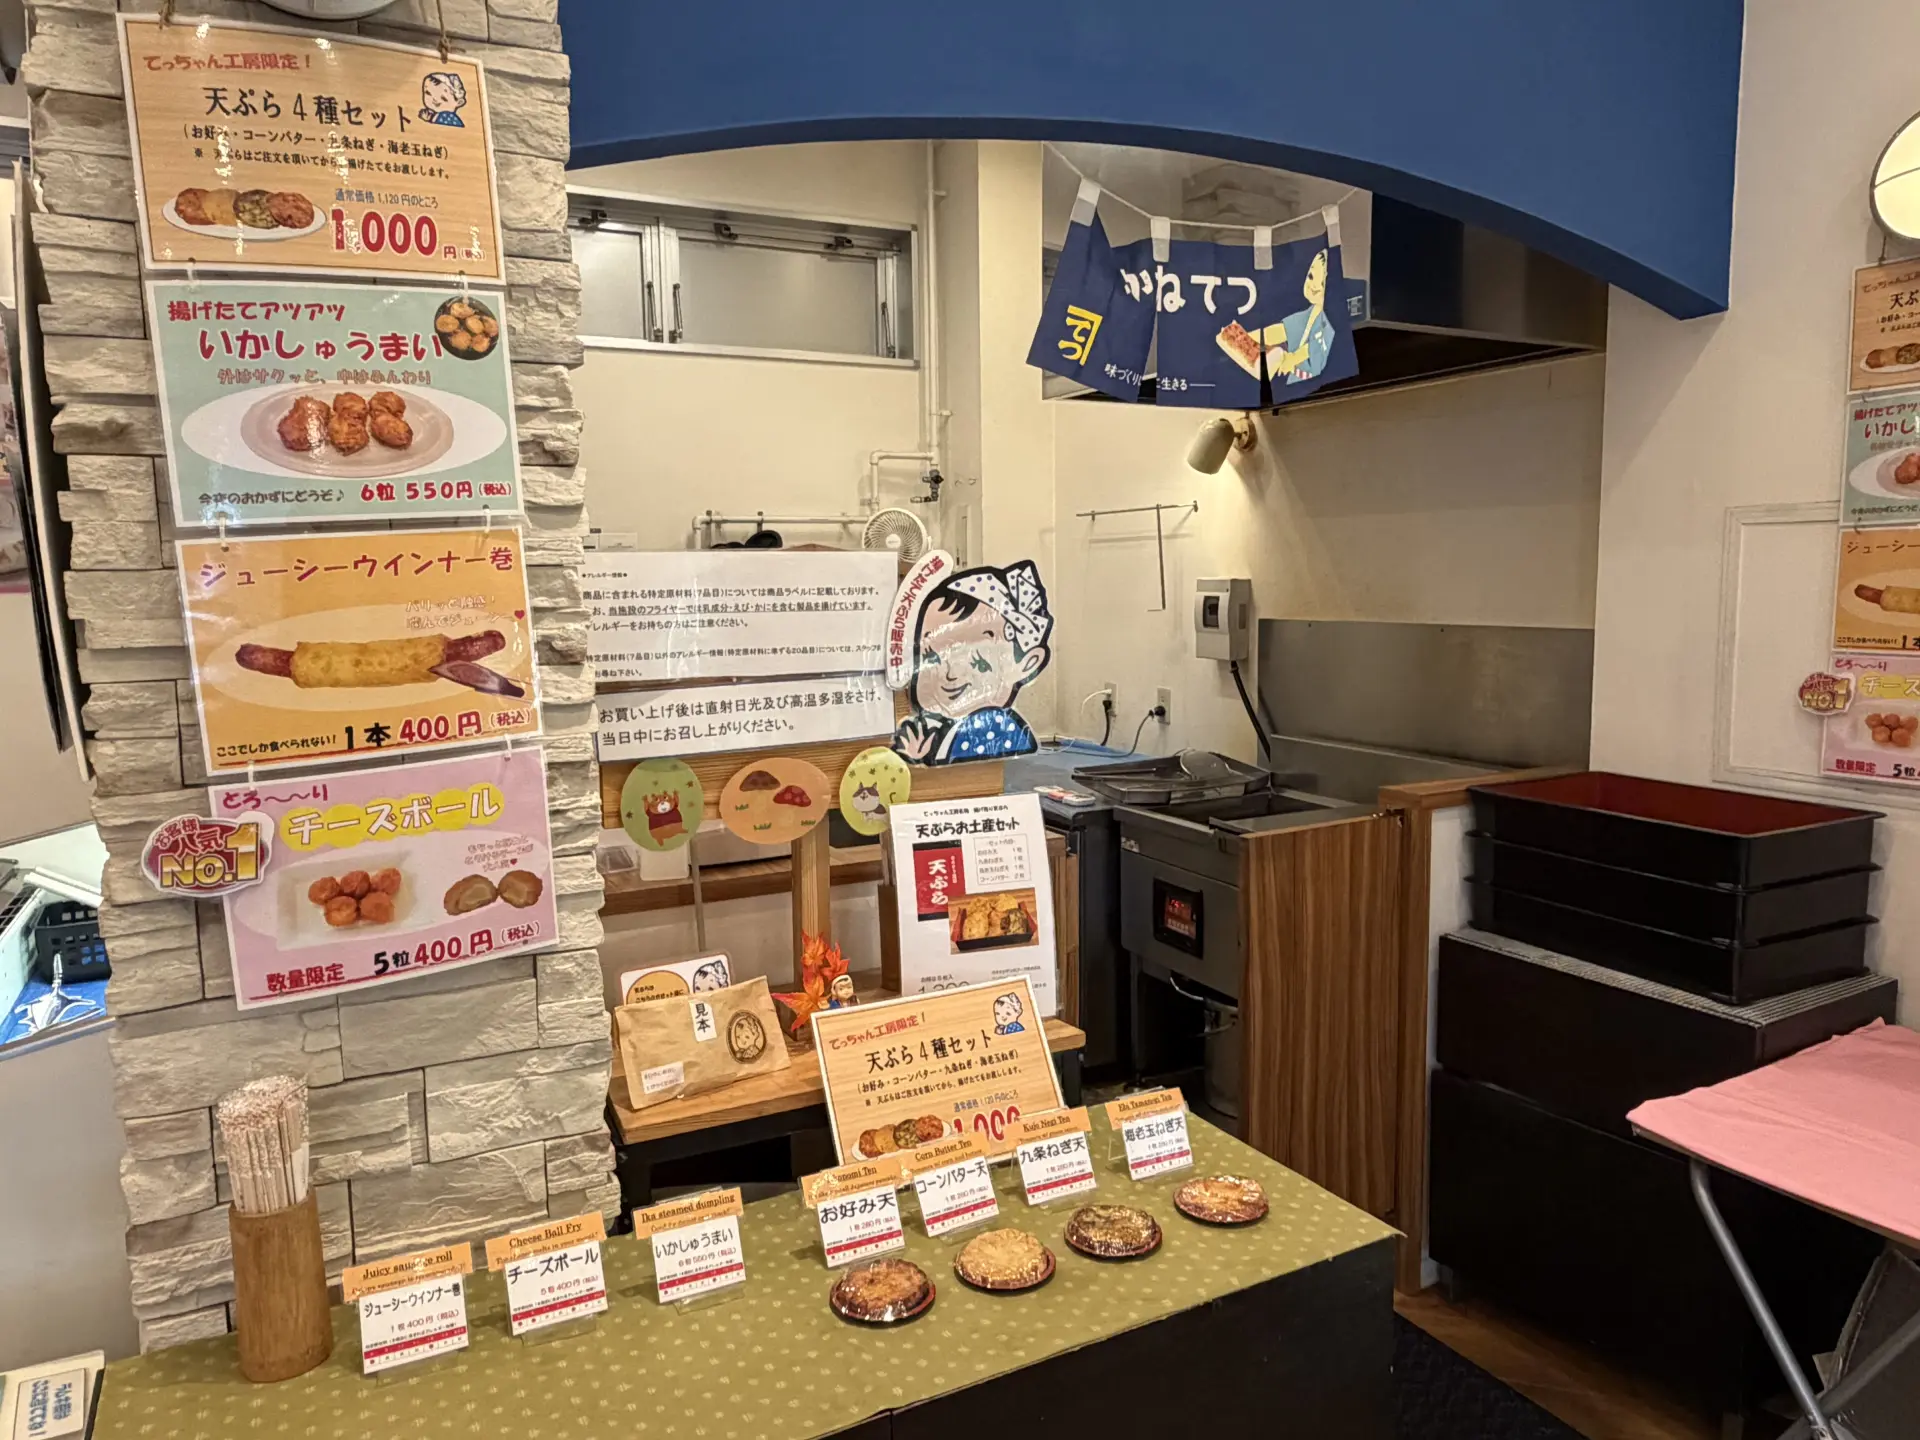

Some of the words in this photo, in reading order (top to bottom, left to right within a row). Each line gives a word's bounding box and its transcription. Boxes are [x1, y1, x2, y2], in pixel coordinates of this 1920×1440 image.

[331, 208, 437, 256] 1000
[1120, 265, 1257, 314] かねてつ
[168, 301, 346, 322] 揚げたてアツアツ
[199, 329, 443, 361] いかしゅうまい
[1855, 402, 1920, 421] 揚げたてアツ
[1865, 419, 1919, 438] いかし
[361, 483, 395, 501] 6粒
[406, 480, 473, 500] 550円
[479, 482, 513, 496] (税込)
[200, 547, 514, 587] ジューシーウインナー巻
[217, 735, 336, 757] ここでしか食べられない!
[345, 722, 391, 751] 1本
[399, 711, 482, 743] 400円
[490, 709, 531, 728] (税込)
[602, 718, 794, 746] 当日中にお召し上がりください。
[289, 788, 500, 846] チーズボール
[916, 816, 1020, 839] 天ぷらお土産セット
[175, 828, 225, 858] 人気
[928, 859, 948, 905] 天ぷら
[266, 963, 346, 992] 数量限定
[373, 950, 409, 977] 5粒
[414, 929, 494, 966] 400円
[501, 921, 541, 943] (税込)
[695, 1003, 711, 1033] 見本
[915, 1151, 933, 1161] Corn
[1020, 1136, 1086, 1164] 九条ねぎ天
[862, 1166, 877, 1176] Ten
[916, 1160, 987, 1194] コーンバター天
[642, 1212, 656, 1223] Ika
[659, 1203, 694, 1218] steamed
[696, 1194, 735, 1210] dumpling
[820, 1192, 896, 1224] お好み天
[509, 1234, 541, 1248] Cheese
[544, 1226, 564, 1239] Ball
[566, 1222, 582, 1235] Fry
[655, 1228, 733, 1258] いかしゅうまい
[363, 1266, 390, 1280] Juicy
[393, 1258, 434, 1273] sausge
[436, 1250, 453, 1264] roll
[508, 1248, 599, 1285] チーズボール
[364, 1283, 461, 1318] ジューシーウインナー巻
